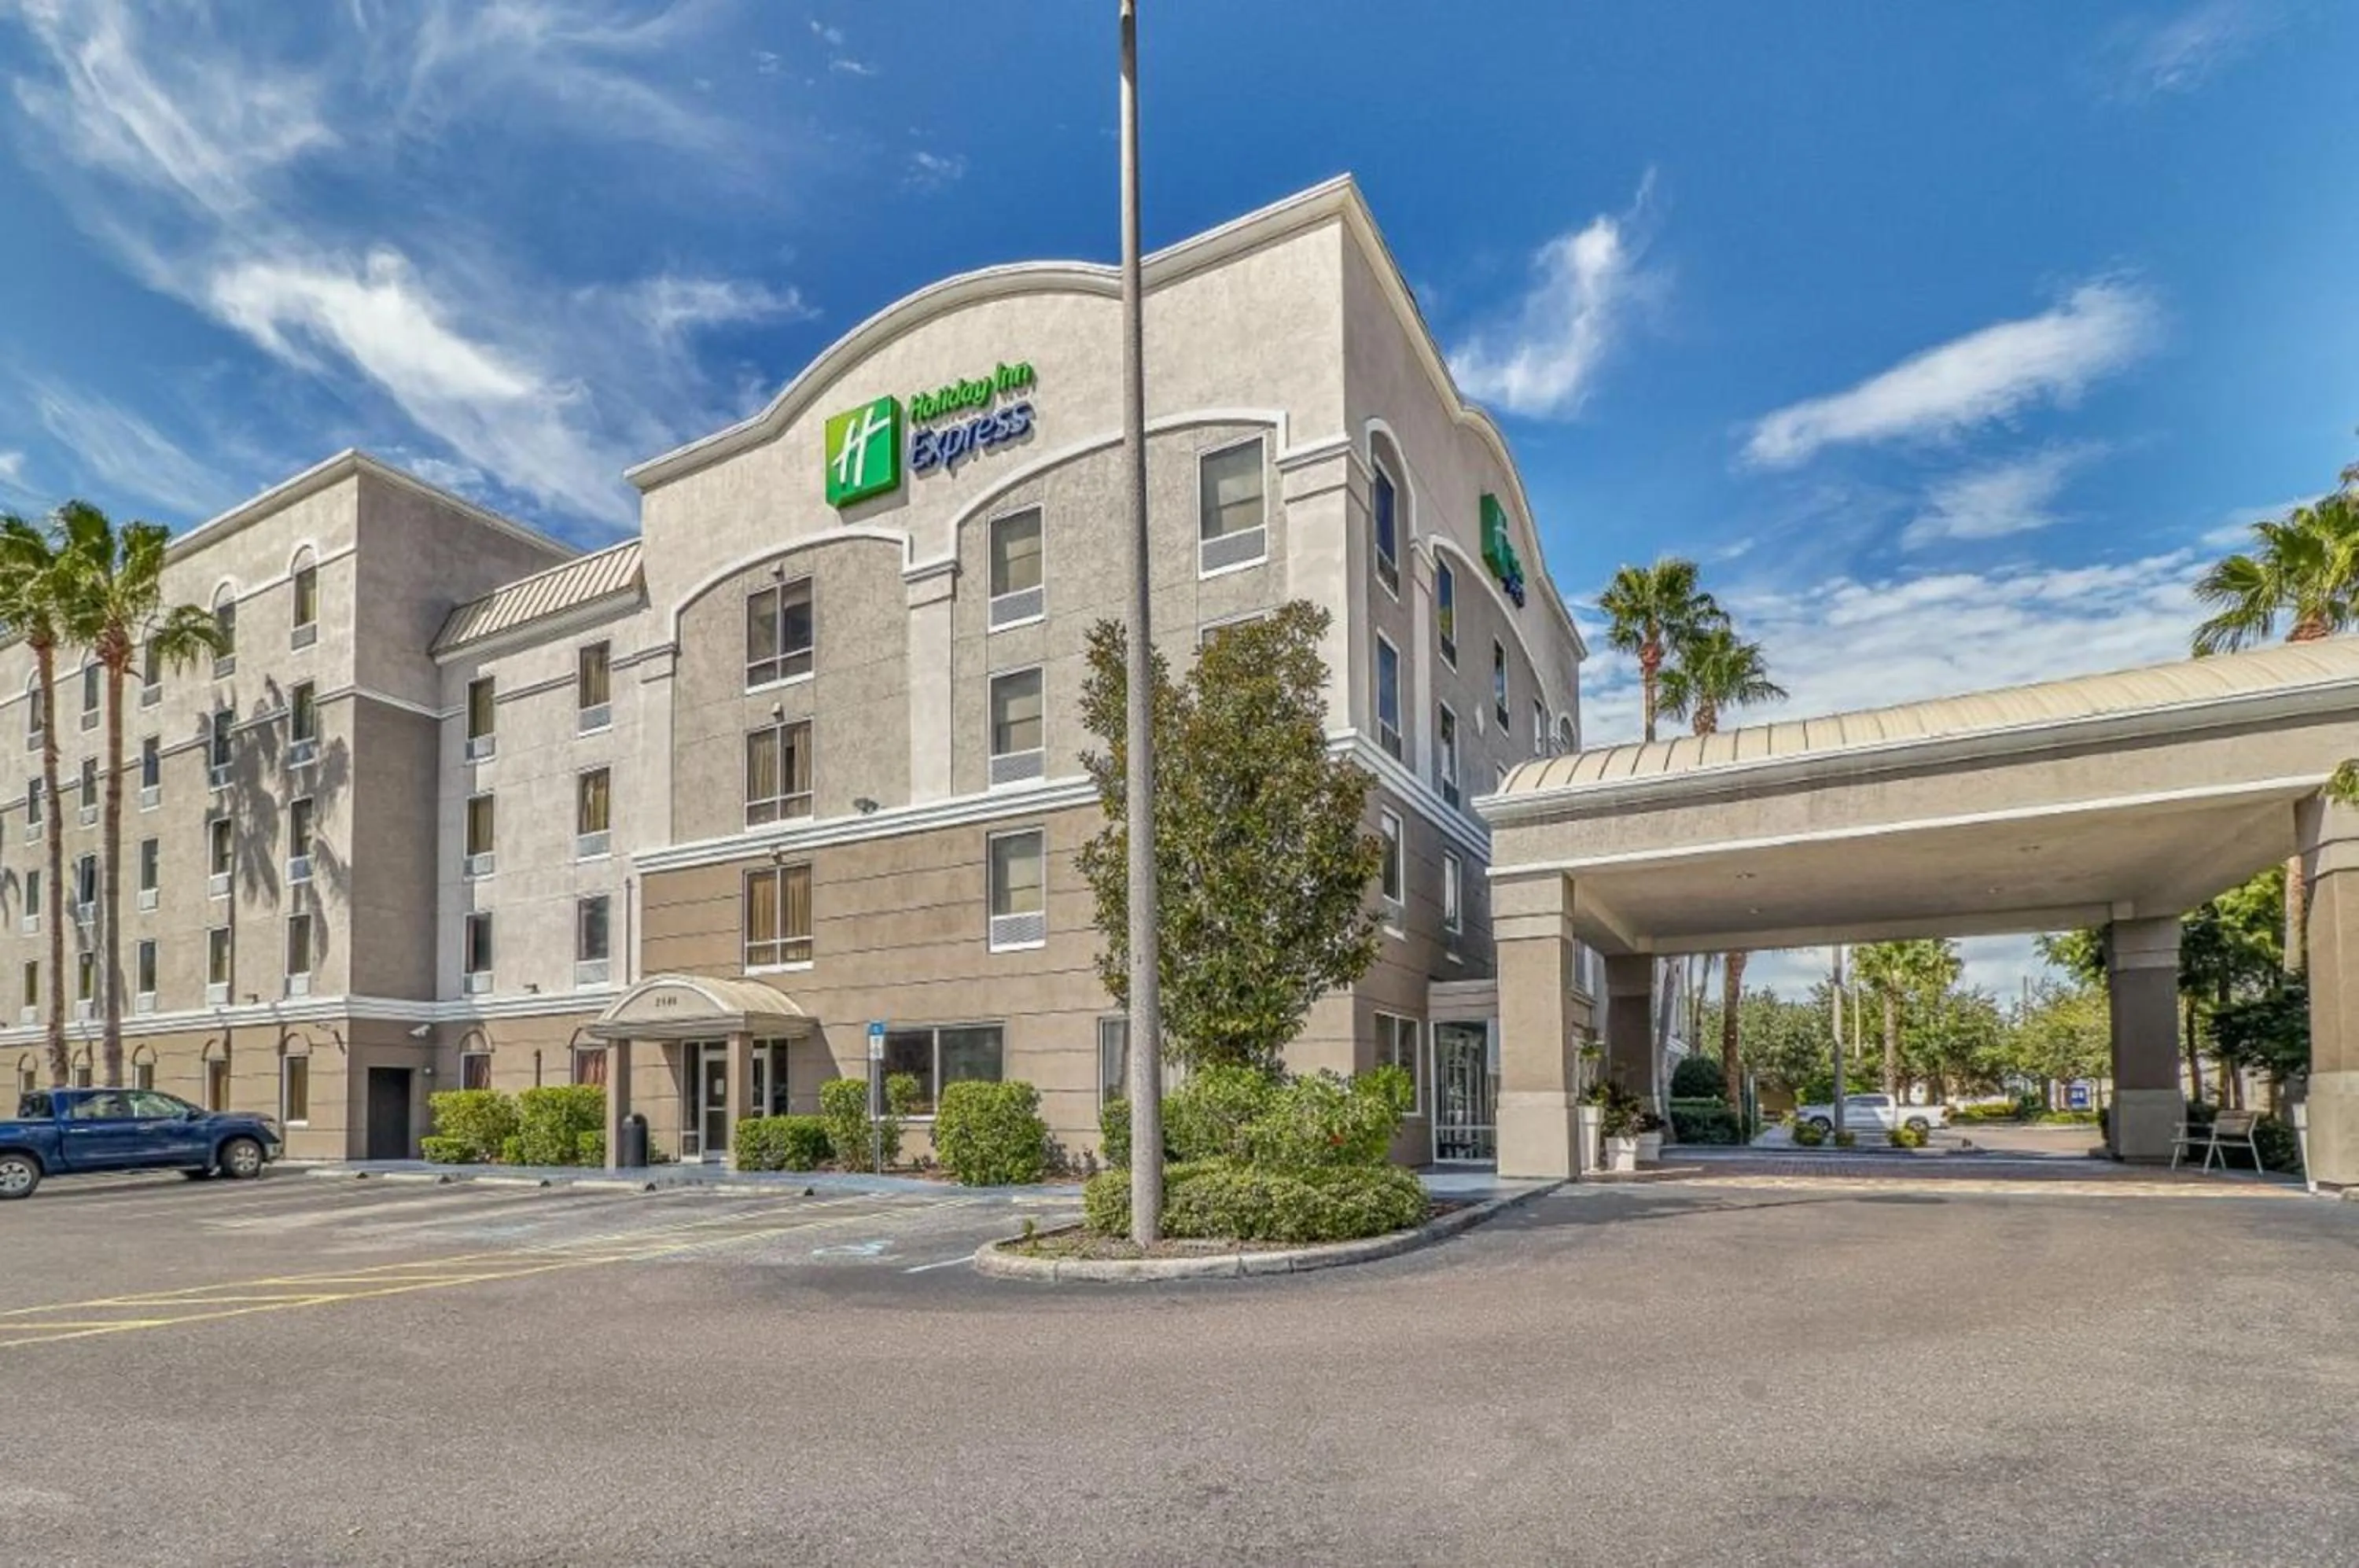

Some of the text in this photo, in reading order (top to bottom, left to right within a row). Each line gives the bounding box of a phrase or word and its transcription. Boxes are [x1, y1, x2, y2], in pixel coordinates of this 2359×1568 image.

[908, 361, 1035, 424] Holiday Inn
[910, 401, 1036, 470] Express
